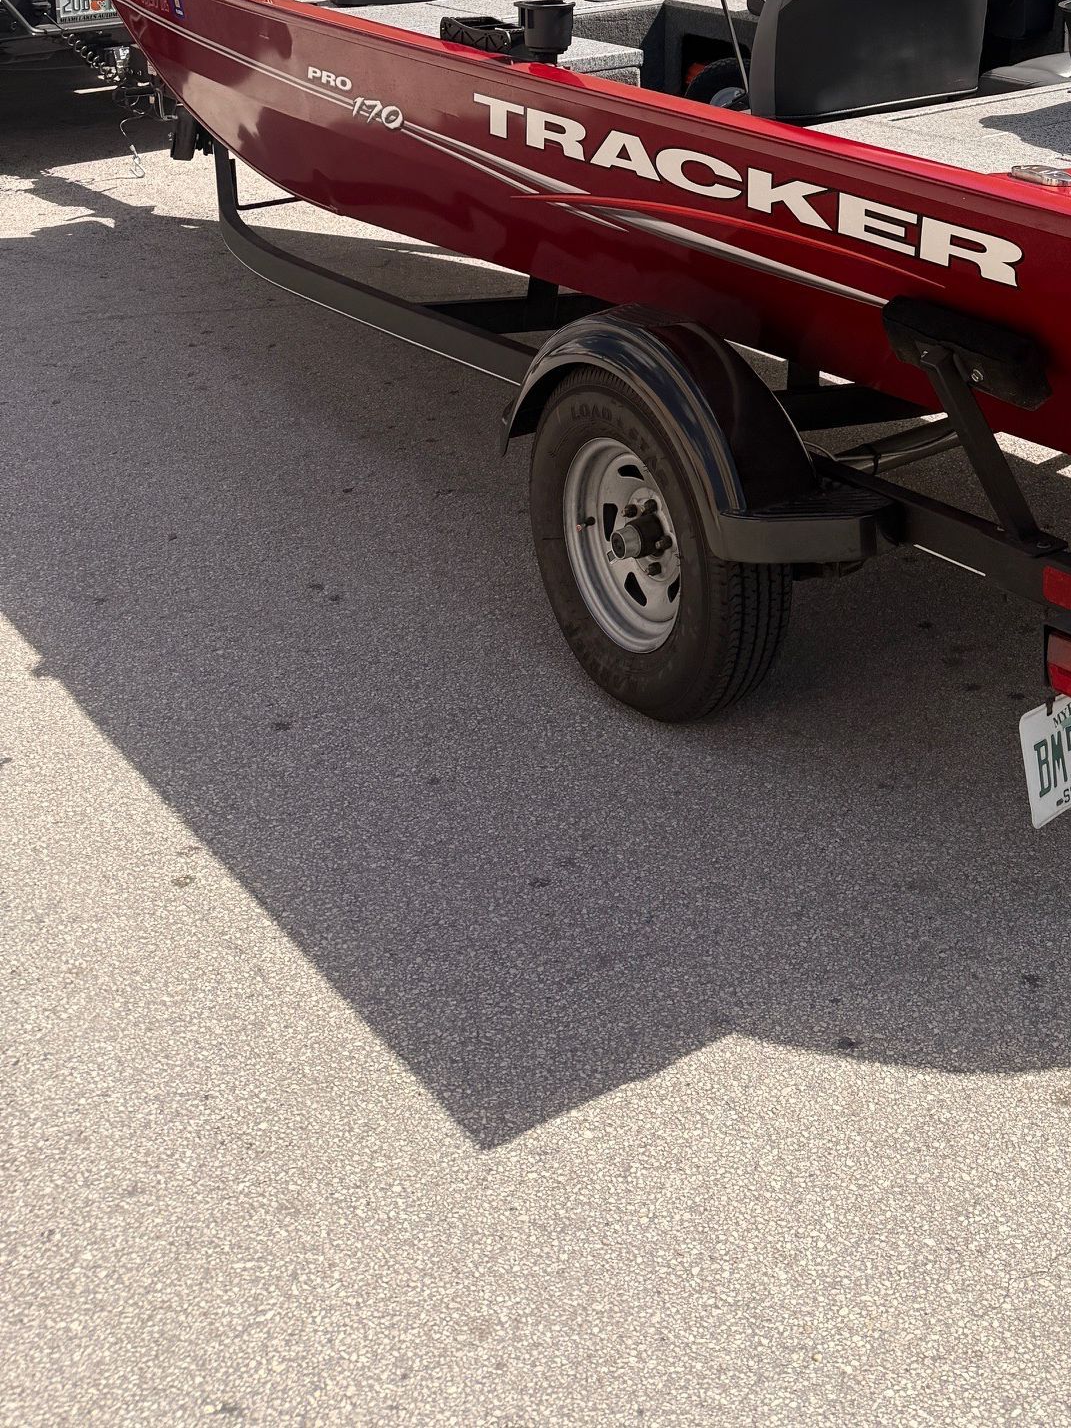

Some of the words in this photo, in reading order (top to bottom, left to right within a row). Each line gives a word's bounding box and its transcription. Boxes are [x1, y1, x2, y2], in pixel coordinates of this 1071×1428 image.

[307, 66, 352, 91] PRO
[352, 97, 403, 129] 170
[473, 92, 1024, 287] TRACKER
